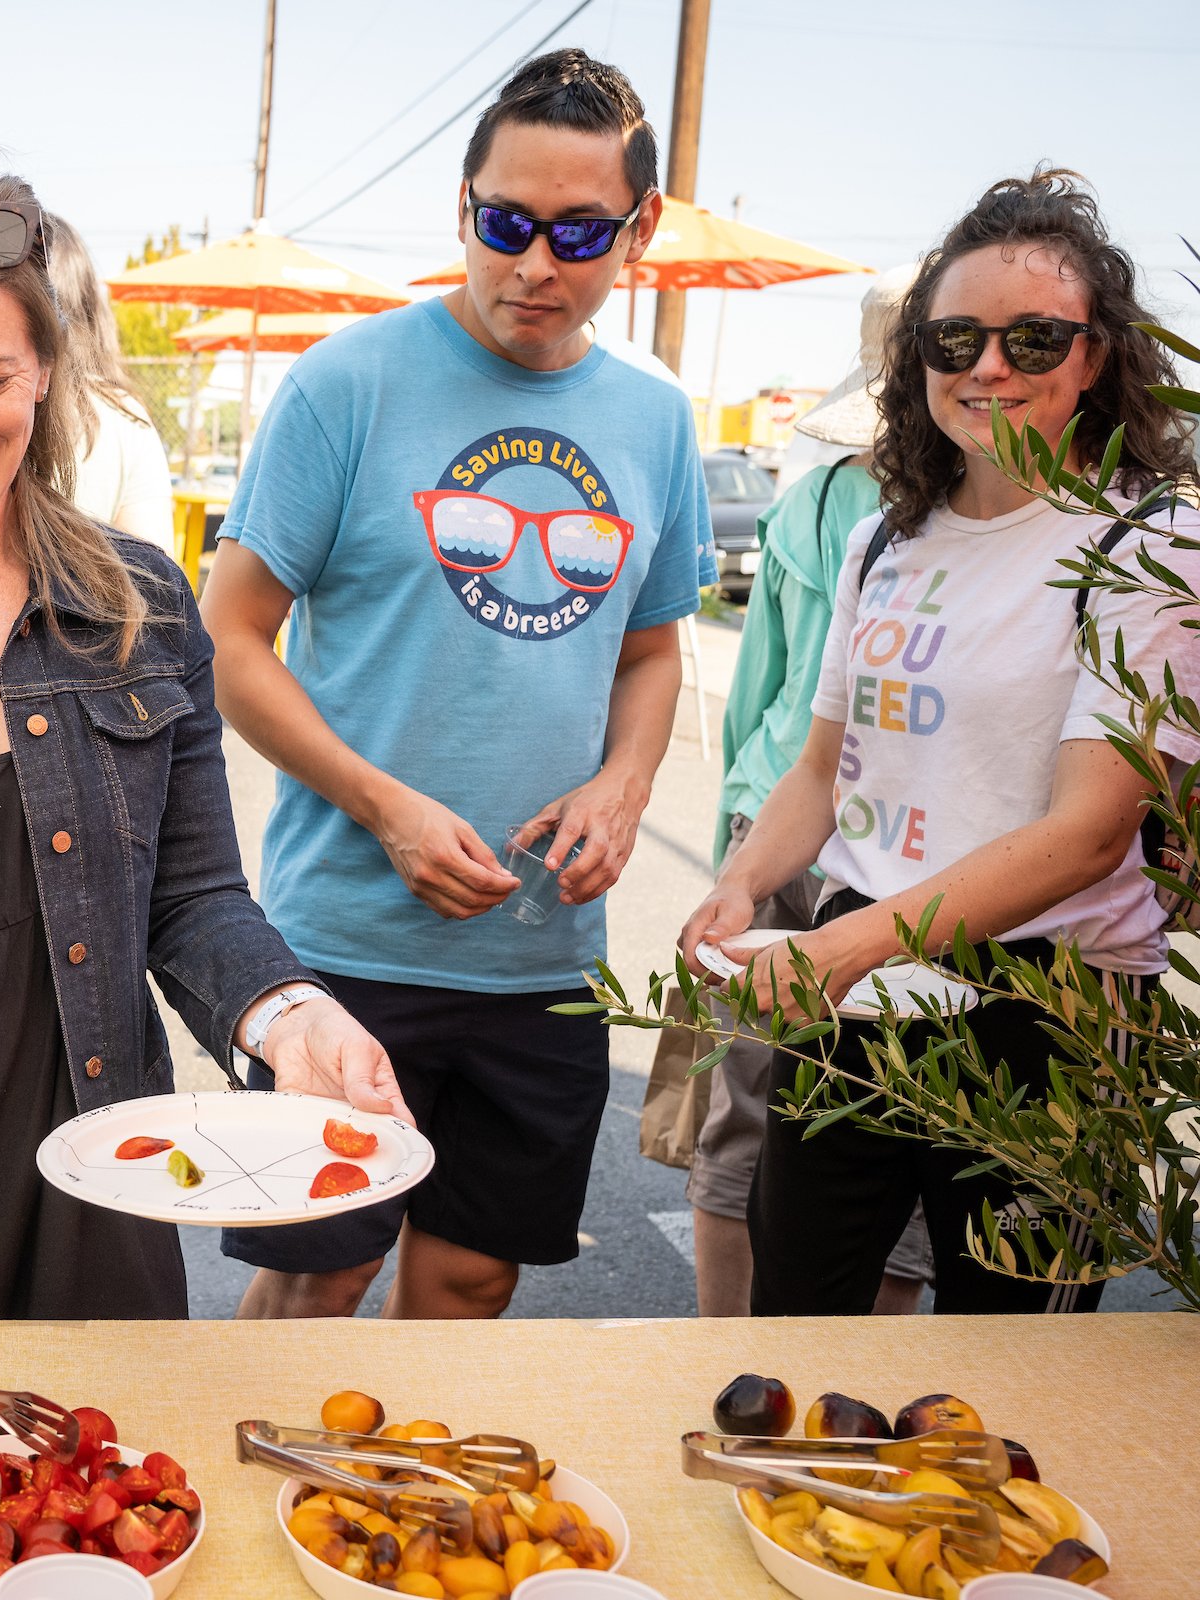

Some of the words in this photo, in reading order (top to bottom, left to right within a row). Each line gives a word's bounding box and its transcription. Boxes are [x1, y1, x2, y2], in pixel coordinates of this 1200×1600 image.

[451, 435, 543, 487] Saving
[549, 441, 607, 508] Lives
[460, 575, 483, 607] is
[480, 599, 501, 621] a
[503, 595, 590, 634] breeze
[865, 566, 949, 616] ALL
[850, 617, 948, 674] YOU
[849, 674, 946, 737] EED
[839, 732, 863, 782] S
[834, 783, 927, 862] OVE
